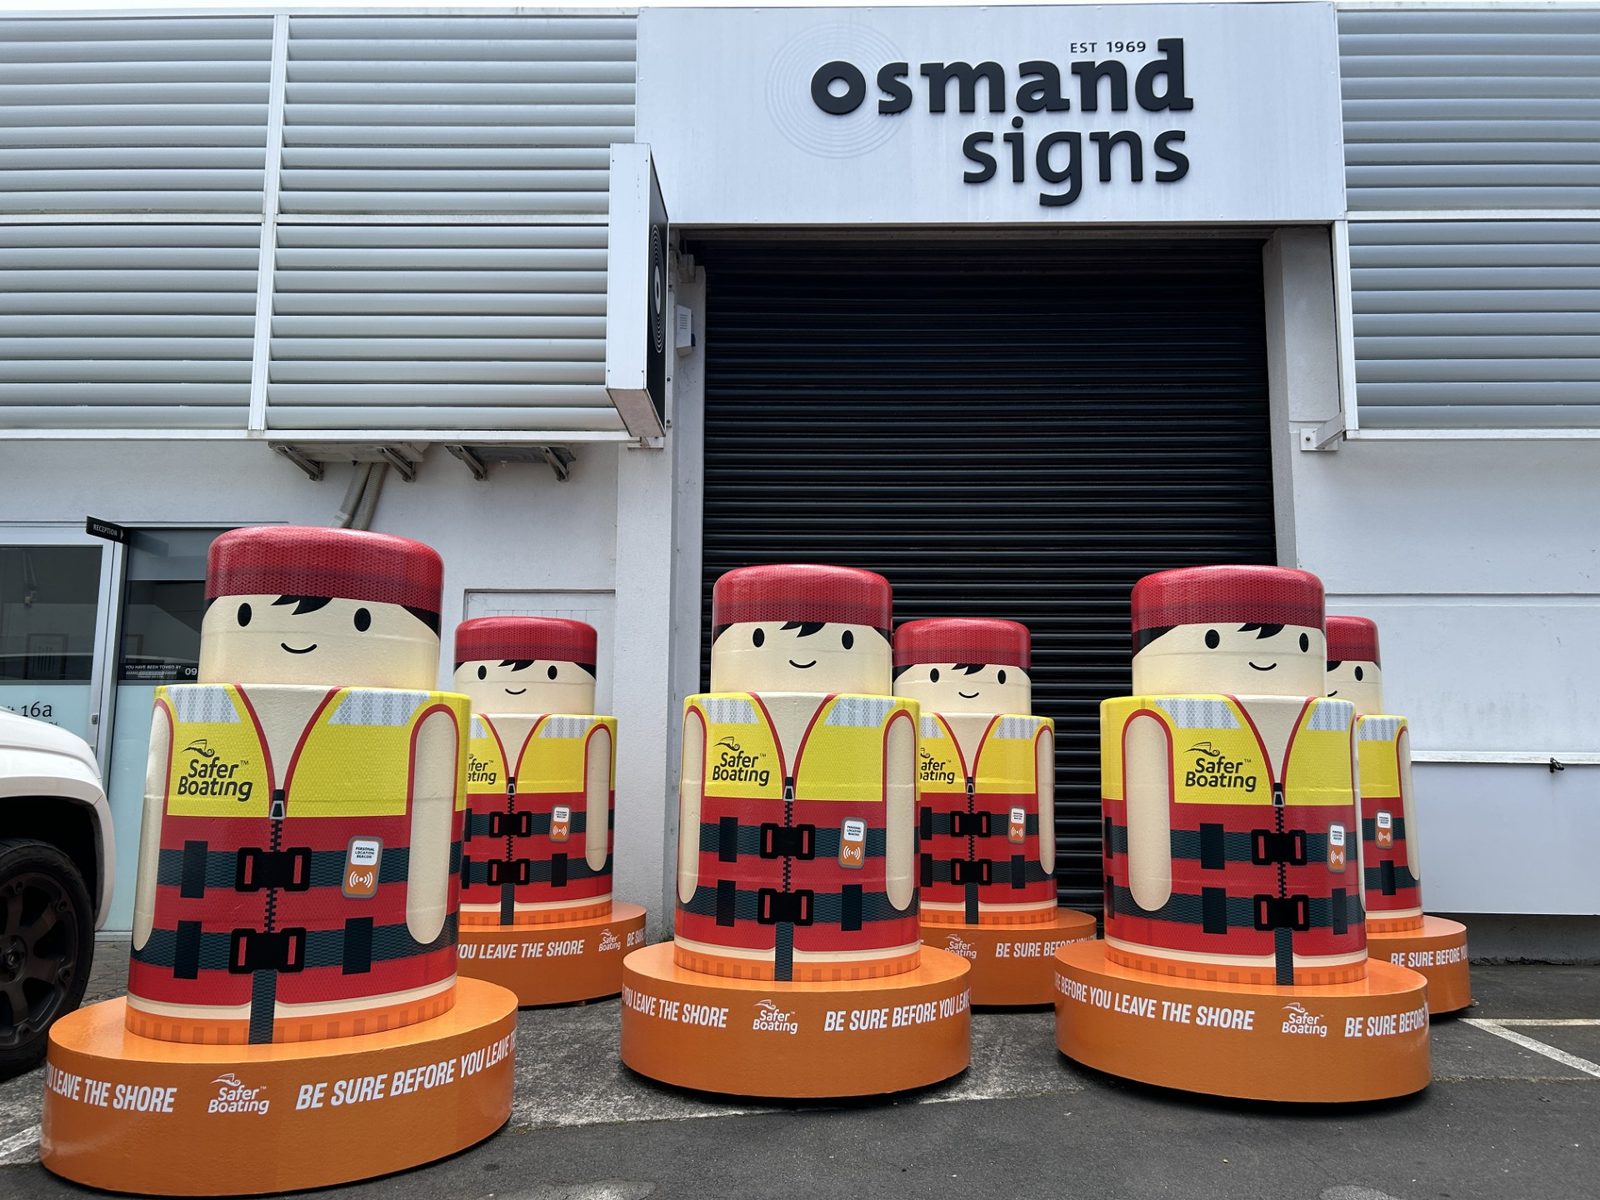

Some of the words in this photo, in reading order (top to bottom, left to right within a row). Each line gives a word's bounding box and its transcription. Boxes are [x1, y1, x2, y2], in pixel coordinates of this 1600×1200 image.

[1069, 42, 1098, 53] EST
[1106, 41, 1146, 53] 1969
[811, 38, 1194, 116] osmand
[962, 115, 1190, 207] signs
[93, 523, 118, 537] RECEPTION
[184, 667, 198, 676] 09
[21, 700, 52, 718] 16a
[188, 756, 239, 778] Safer
[720, 750, 759, 768] Safer
[1194, 756, 1243, 774] Safer
[712, 765, 770, 787] Boating
[1185, 771, 1257, 793] Boating
[177, 776, 253, 802] Boating
[479, 943, 519, 959] LEAVE
[521, 942, 545, 958] THE
[546, 939, 585, 957] SHORE
[996, 942, 1011, 958] BE
[1013, 942, 1041, 957] SURE
[1408, 951, 1434, 967] SURE
[1435, 947, 1460, 966] BEFORE
[633, 991, 656, 1017] LEAVE
[658, 998, 680, 1021] THE
[682, 1003, 729, 1028] SHORE
[1061, 975, 1088, 1003] BEFORE
[1089, 986, 1111, 1009] YOU
[1114, 993, 1157, 1018] LEAVE
[1161, 1001, 1192, 1024] THE
[1196, 1005, 1256, 1031] SHORE
[760, 1009, 790, 1021] Safer
[824, 1010, 846, 1032] BE
[849, 1007, 889, 1031] SURE
[892, 1001, 938, 1028] BEFORE
[939, 998, 955, 1019] YOU
[1288, 1012, 1319, 1025] Safer
[752, 1018, 798, 1035] Boating
[1281, 1021, 1328, 1037] Boating
[1344, 1017, 1364, 1038] BE
[1366, 1014, 1397, 1037] SURE
[295, 1082, 328, 1111] BE
[330, 1073, 389, 1107] SURE
[390, 1058, 457, 1098] BEFORE
[460, 1048, 485, 1079] YOU
[53, 1068, 82, 1101] LEAVE
[84, 1078, 112, 1107] THE
[112, 1083, 177, 1113] SHORE
[218, 1084, 259, 1101] Safer
[208, 1098, 270, 1115] Boating
